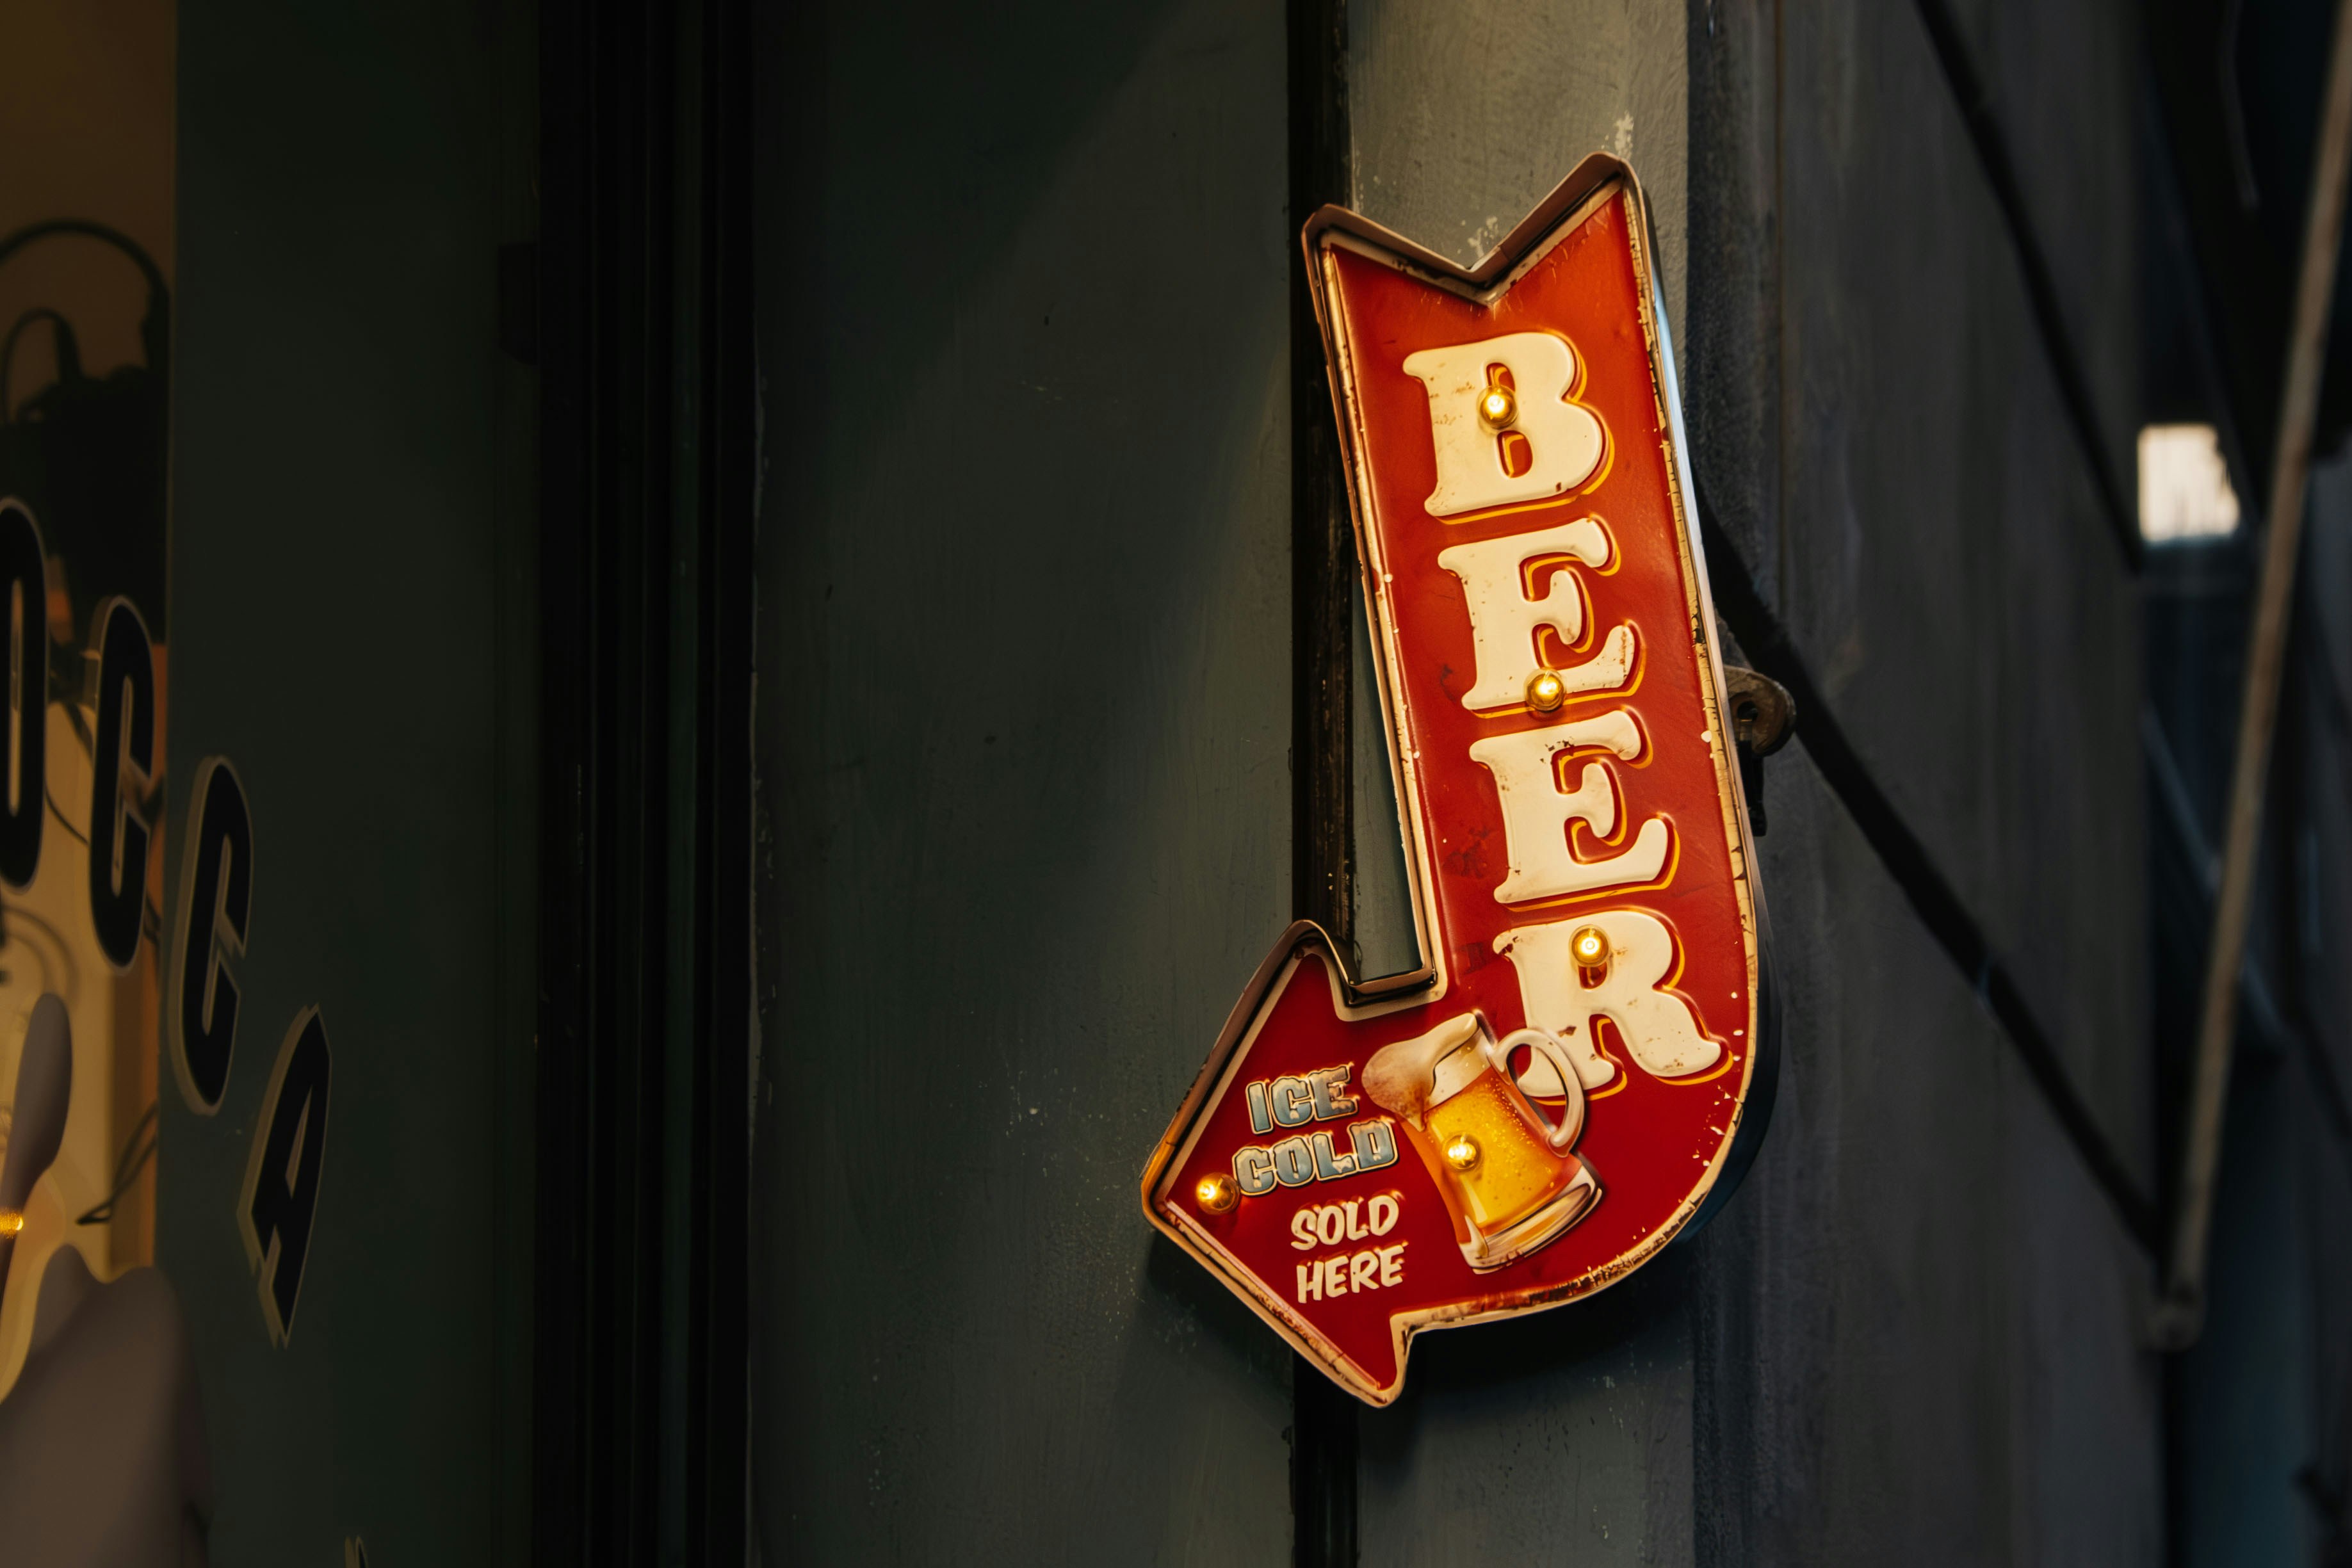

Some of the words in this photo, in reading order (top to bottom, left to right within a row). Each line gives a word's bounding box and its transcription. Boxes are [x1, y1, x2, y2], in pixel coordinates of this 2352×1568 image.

[1402, 332, 1732, 1103] BEER
[1245, 1063, 1358, 1135] ICE
[1232, 1119, 1398, 1196] COLD
[1290, 1194, 1400, 1250] SOLD
[1295, 1244, 1406, 1304] HERE
